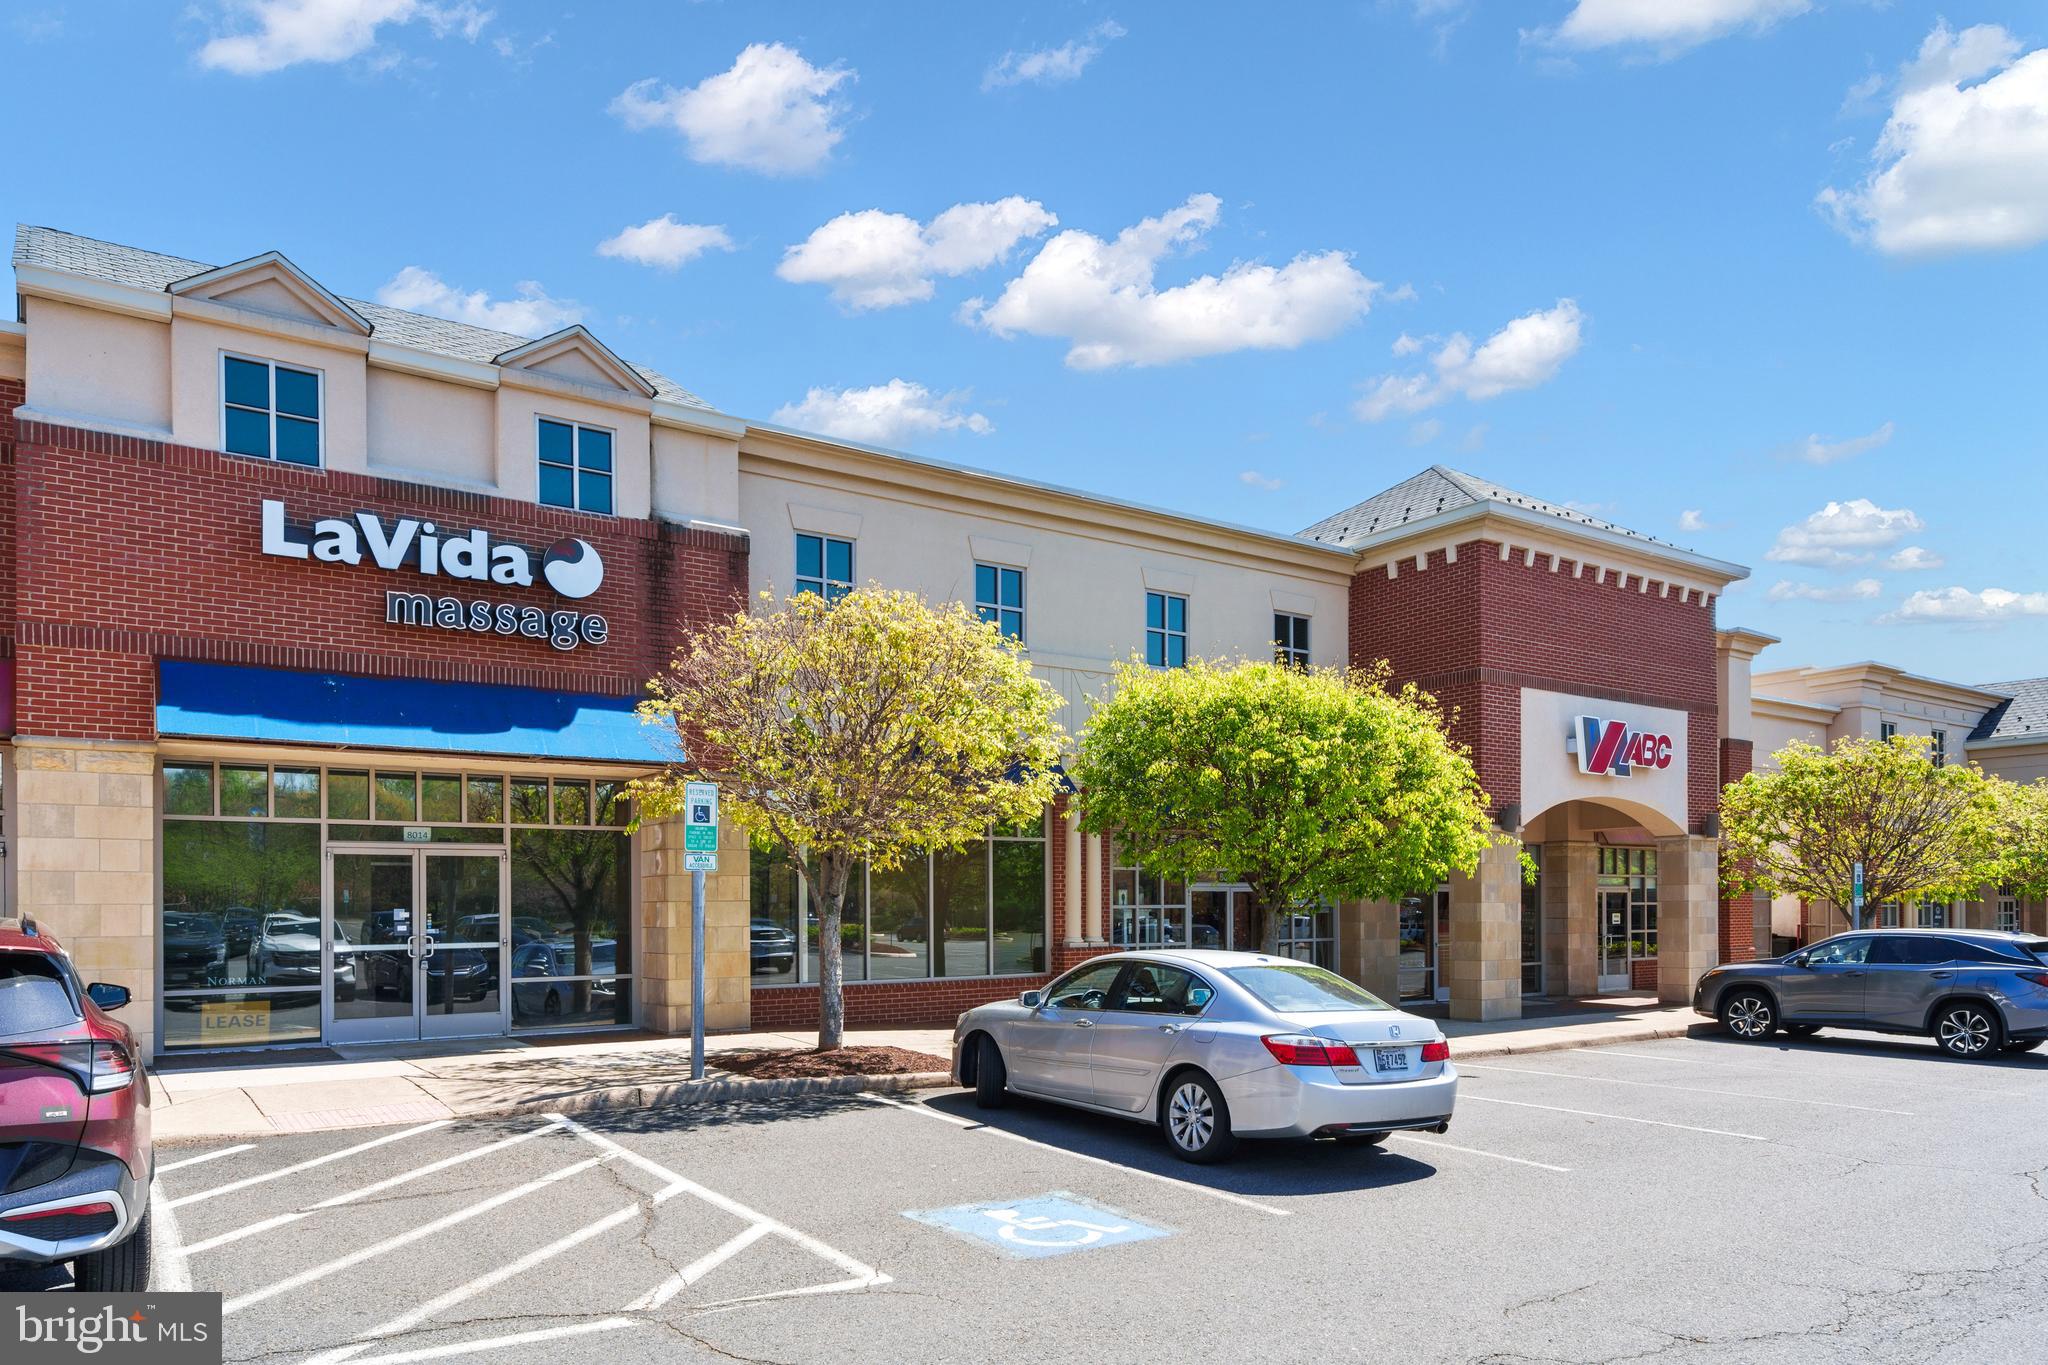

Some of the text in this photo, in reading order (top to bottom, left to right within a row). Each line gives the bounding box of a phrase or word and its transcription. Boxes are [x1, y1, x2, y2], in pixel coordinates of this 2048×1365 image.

[261, 499, 533, 587] LaVida
[386, 590, 609, 652] massage
[407, 831, 428, 839] 8014
[206, 1014, 267, 1029] LEASE
